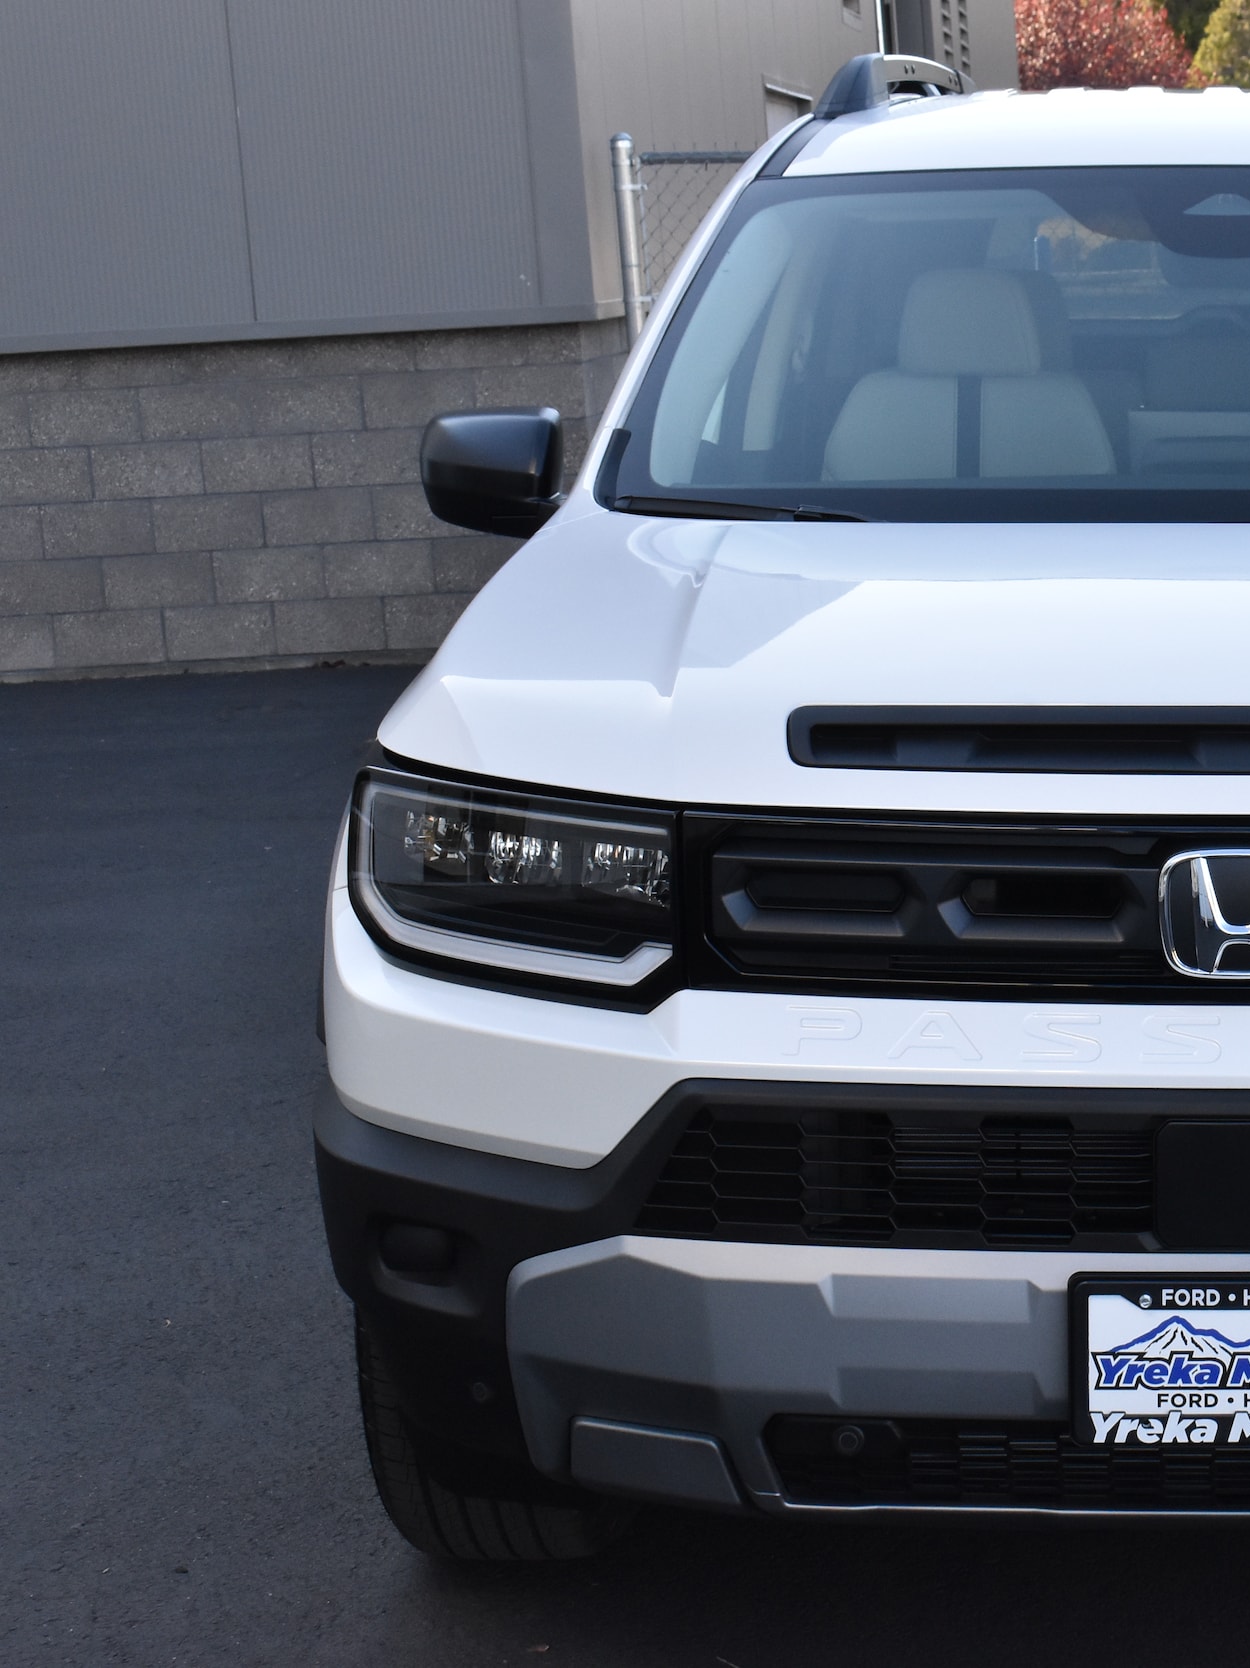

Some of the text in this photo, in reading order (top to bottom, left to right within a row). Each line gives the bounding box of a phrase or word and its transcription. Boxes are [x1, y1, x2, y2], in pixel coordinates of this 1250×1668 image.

[1161, 1288, 1221, 1307] FORD
[1098, 1353, 1221, 1388] Yreka
[1157, 1392, 1219, 1408] FORD
[1090, 1410, 1219, 1444] Yreka
